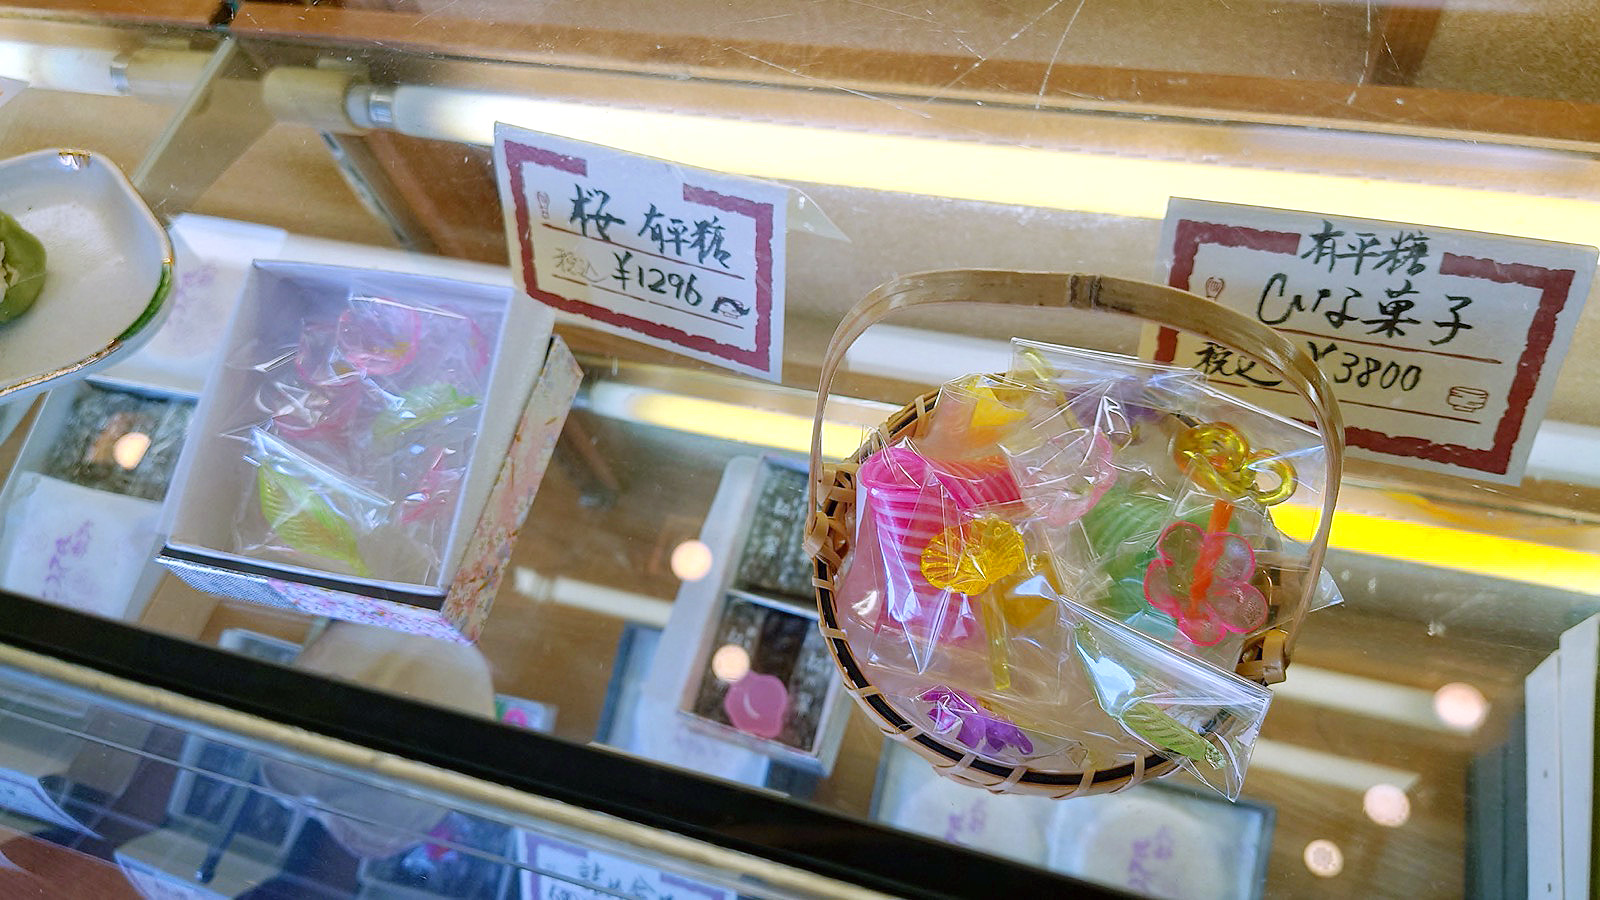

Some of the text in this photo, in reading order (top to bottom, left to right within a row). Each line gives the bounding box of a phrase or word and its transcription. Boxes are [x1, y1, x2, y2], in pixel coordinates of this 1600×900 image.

[569, 183, 731, 269] 桜 有平糖
[1301, 219, 1431, 277] 有平糖
[611, 251, 703, 307] ¥1296
[1257, 272, 1473, 346] ひな菓子
